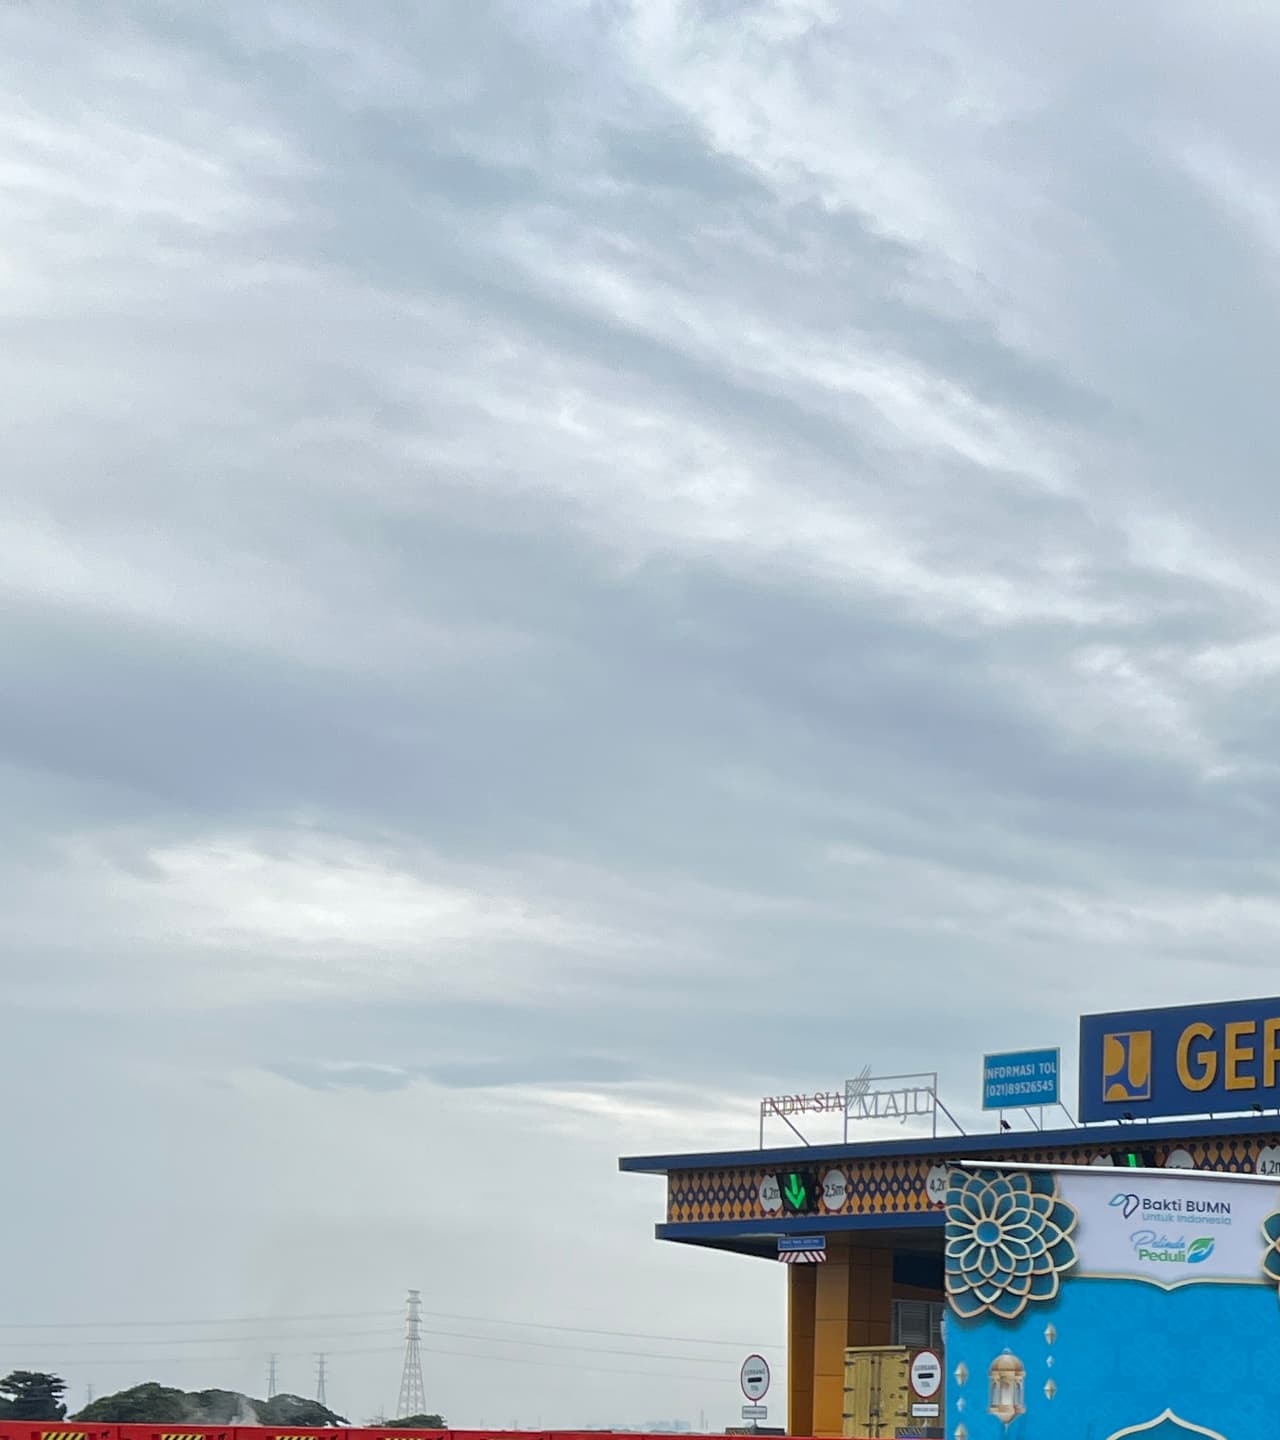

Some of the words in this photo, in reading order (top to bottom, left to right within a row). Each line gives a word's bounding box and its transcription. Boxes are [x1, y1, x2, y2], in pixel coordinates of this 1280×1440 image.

[984, 1063, 1036, 1080] INFORMASI
[1039, 1061, 1057, 1075] TOL
[986, 1080, 1055, 1099] (021)89526545
[825, 1183, 844, 1199] 2,5m
[1142, 1197, 1182, 1212] Bakti
[1186, 1199, 1231, 1215] BUMN
[1142, 1212, 1175, 1223] Untuk
[1177, 1214, 1232, 1226] Indonesia
[1138, 1248, 1186, 1263] Peduli
